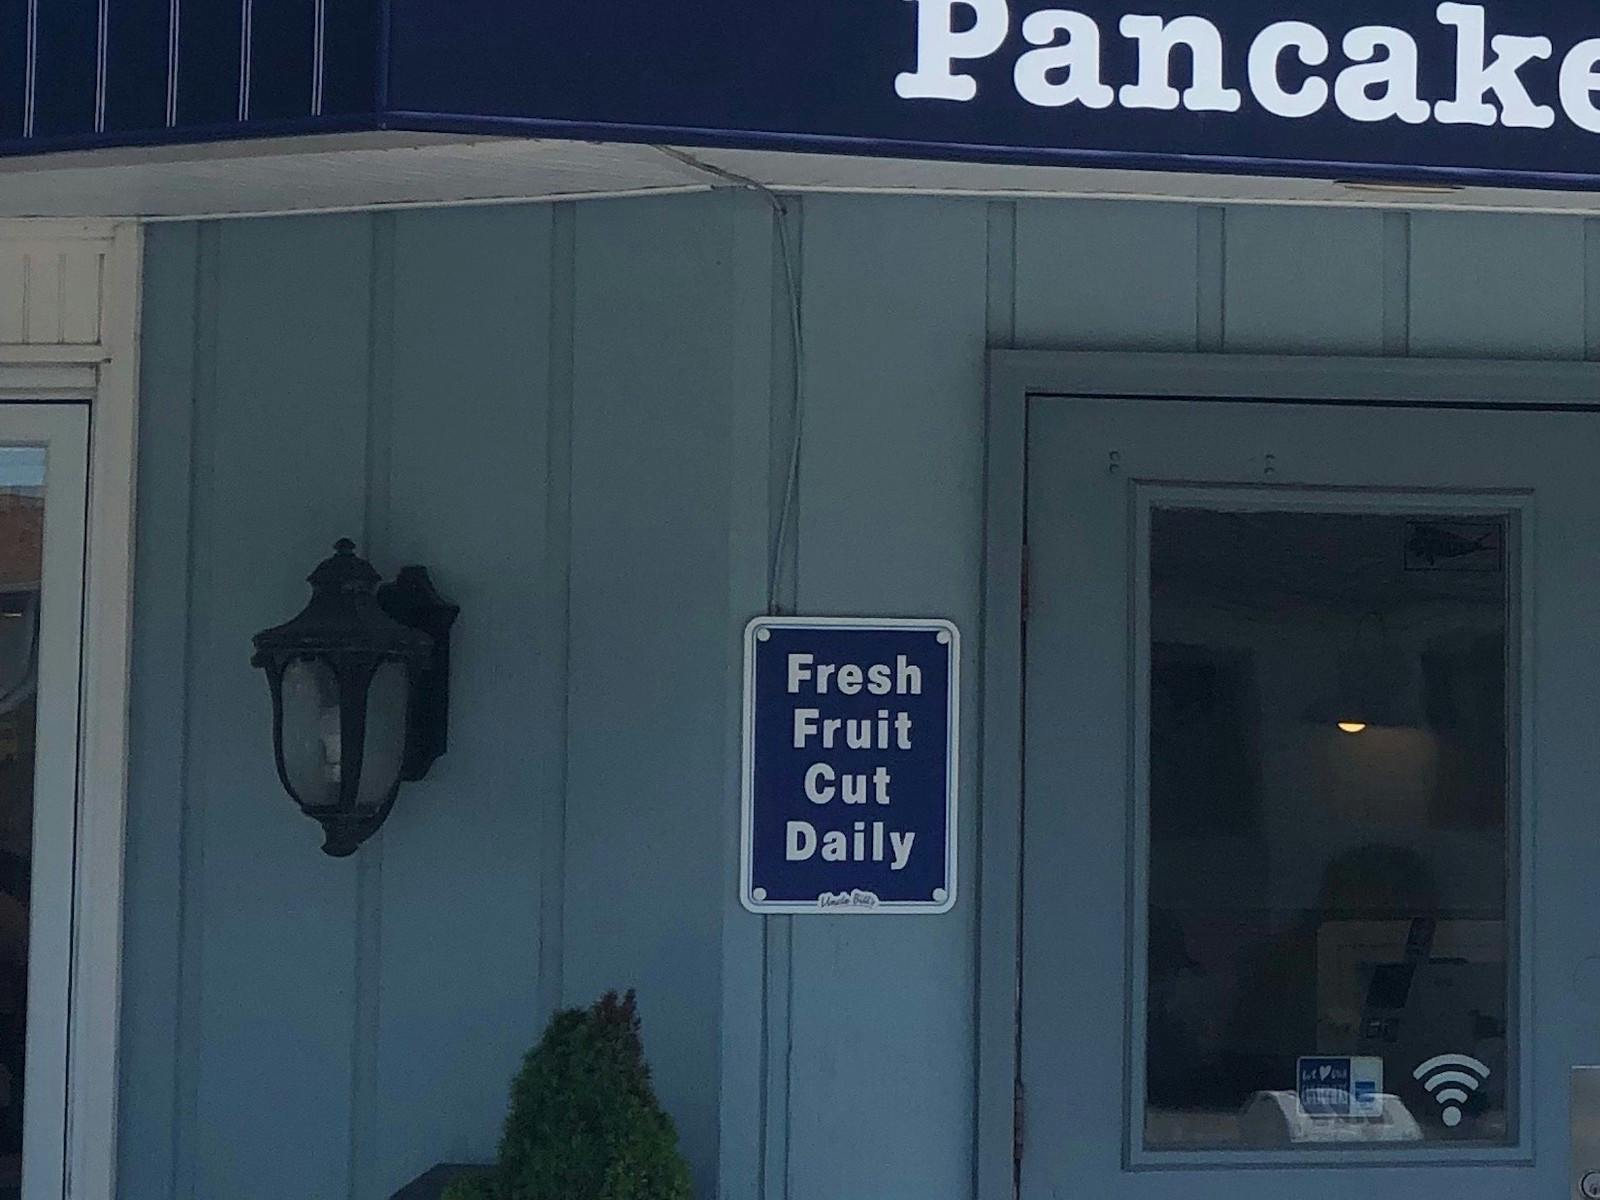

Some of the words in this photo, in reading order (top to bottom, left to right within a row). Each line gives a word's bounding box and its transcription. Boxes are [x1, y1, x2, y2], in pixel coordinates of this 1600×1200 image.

[787, 653, 921, 695] Fresh
[793, 708, 912, 749] Fruit
[804, 762, 891, 804] Cut
[785, 820, 915, 870] Daily
